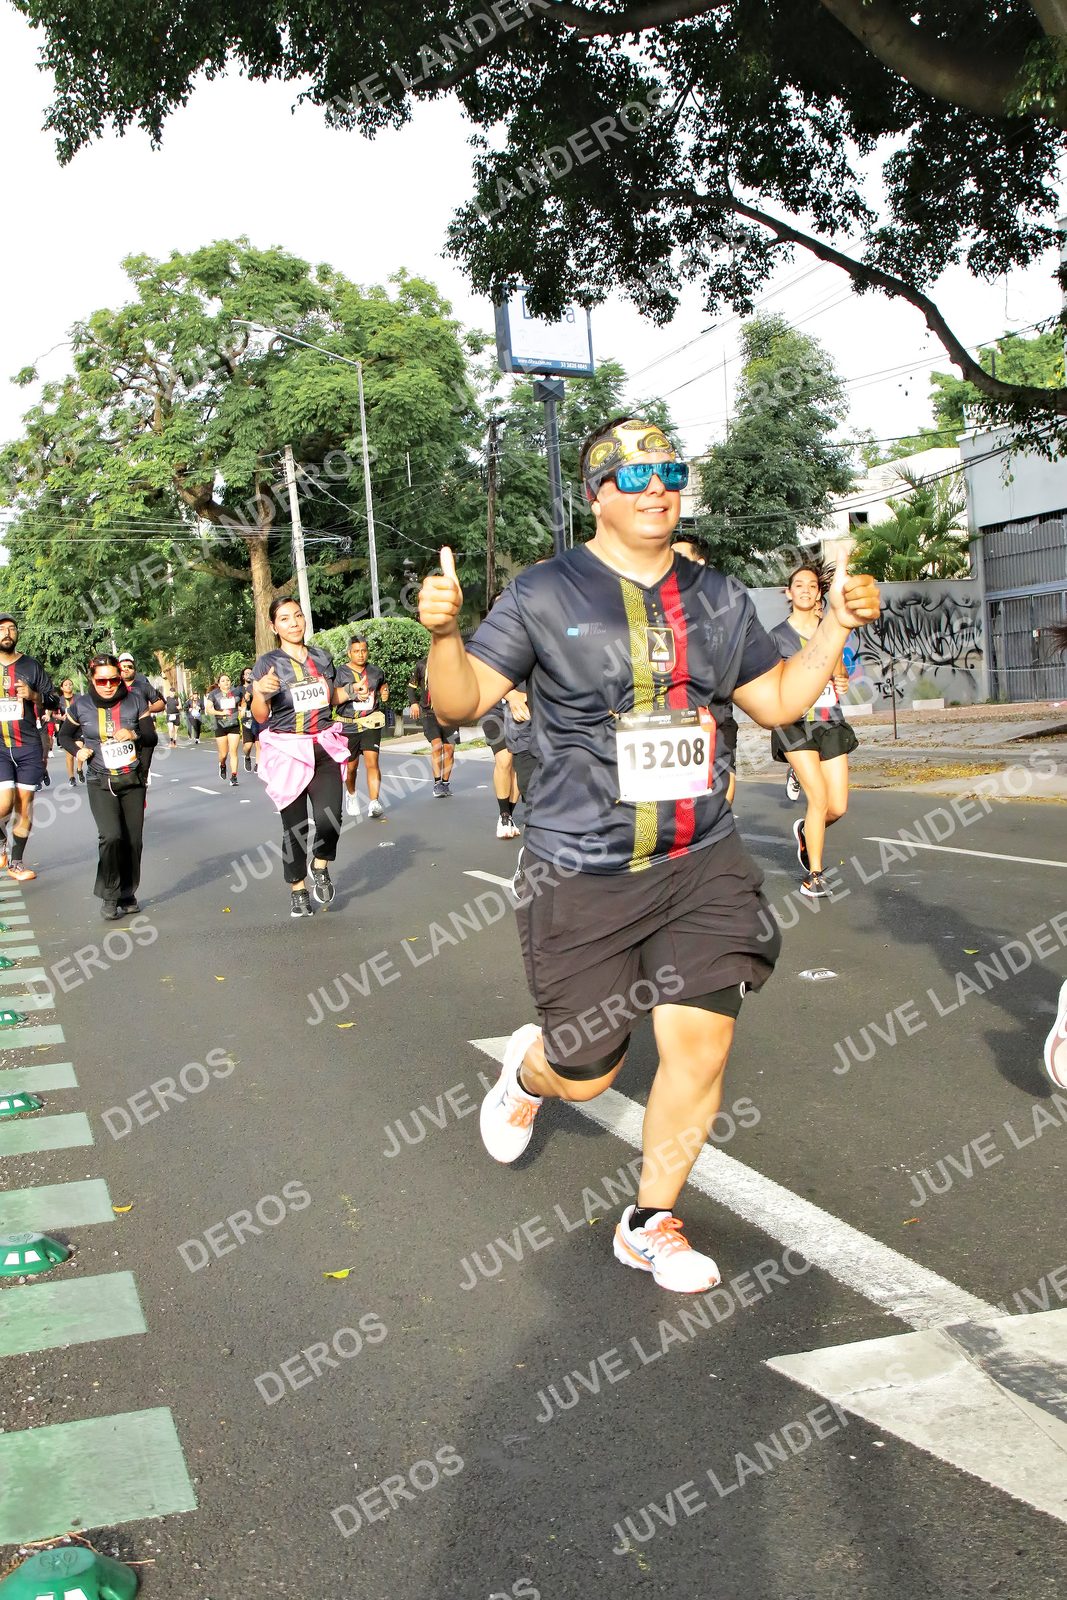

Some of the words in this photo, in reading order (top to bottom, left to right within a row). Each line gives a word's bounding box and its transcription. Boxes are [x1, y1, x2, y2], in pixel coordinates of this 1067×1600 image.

[294, 686, 325, 702] 12904
[105, 743, 134, 758] 12889
[624, 737, 705, 770] 13208
